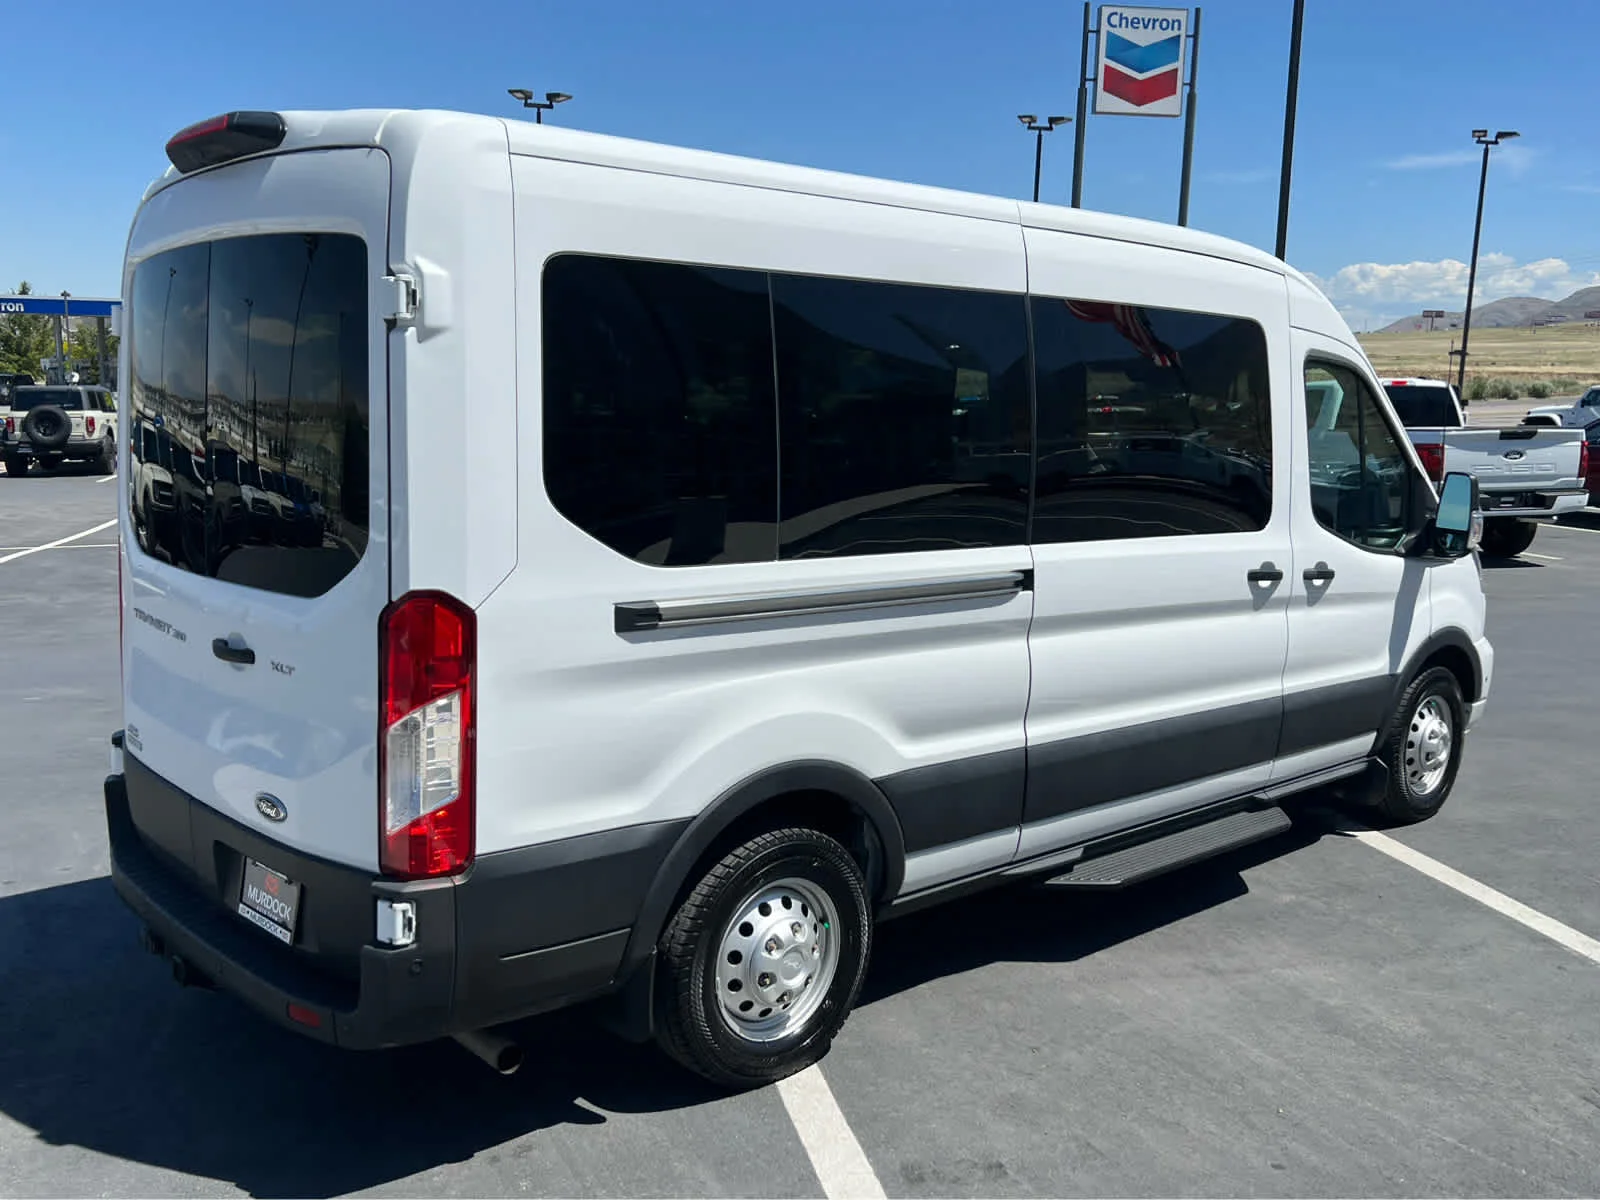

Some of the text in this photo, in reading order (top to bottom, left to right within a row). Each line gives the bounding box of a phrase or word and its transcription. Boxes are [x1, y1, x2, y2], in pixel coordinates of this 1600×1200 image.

[1107, 11, 1182, 31] Chevron
[270, 660, 296, 677] XLT
[258, 799, 280, 817] Ford
[247, 883, 292, 921] MURDOCK
